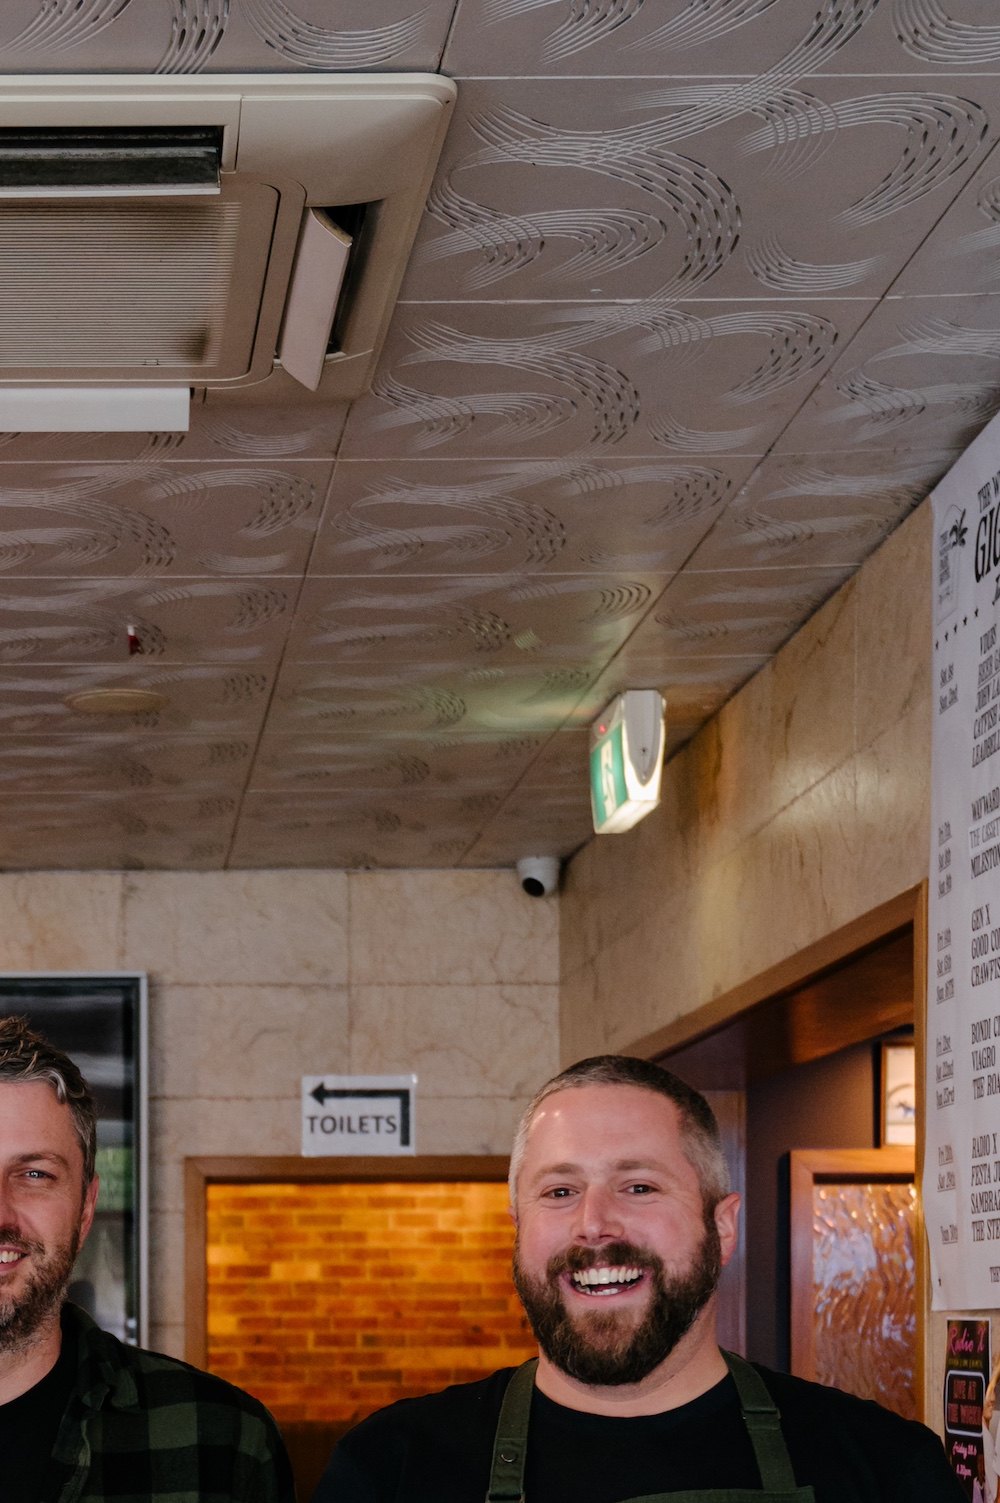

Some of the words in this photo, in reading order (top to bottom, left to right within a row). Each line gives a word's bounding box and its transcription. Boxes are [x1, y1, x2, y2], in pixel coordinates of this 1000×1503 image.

[971, 906, 984, 932] GEN
[985, 903, 991, 926] X
[971, 933, 989, 960] GOOD
[971, 1018, 991, 1045] BONDI
[972, 1045, 996, 1071] VIAGRO
[972, 1076, 985, 1100] THE
[307, 1115, 397, 1134] TOILETS
[971, 1134, 991, 1159] RADIO
[992, 1132, 998, 1155] X
[971, 1163, 991, 1187] FESTA
[972, 1220, 985, 1242] THE
[949, 1327, 974, 1356] Radio
